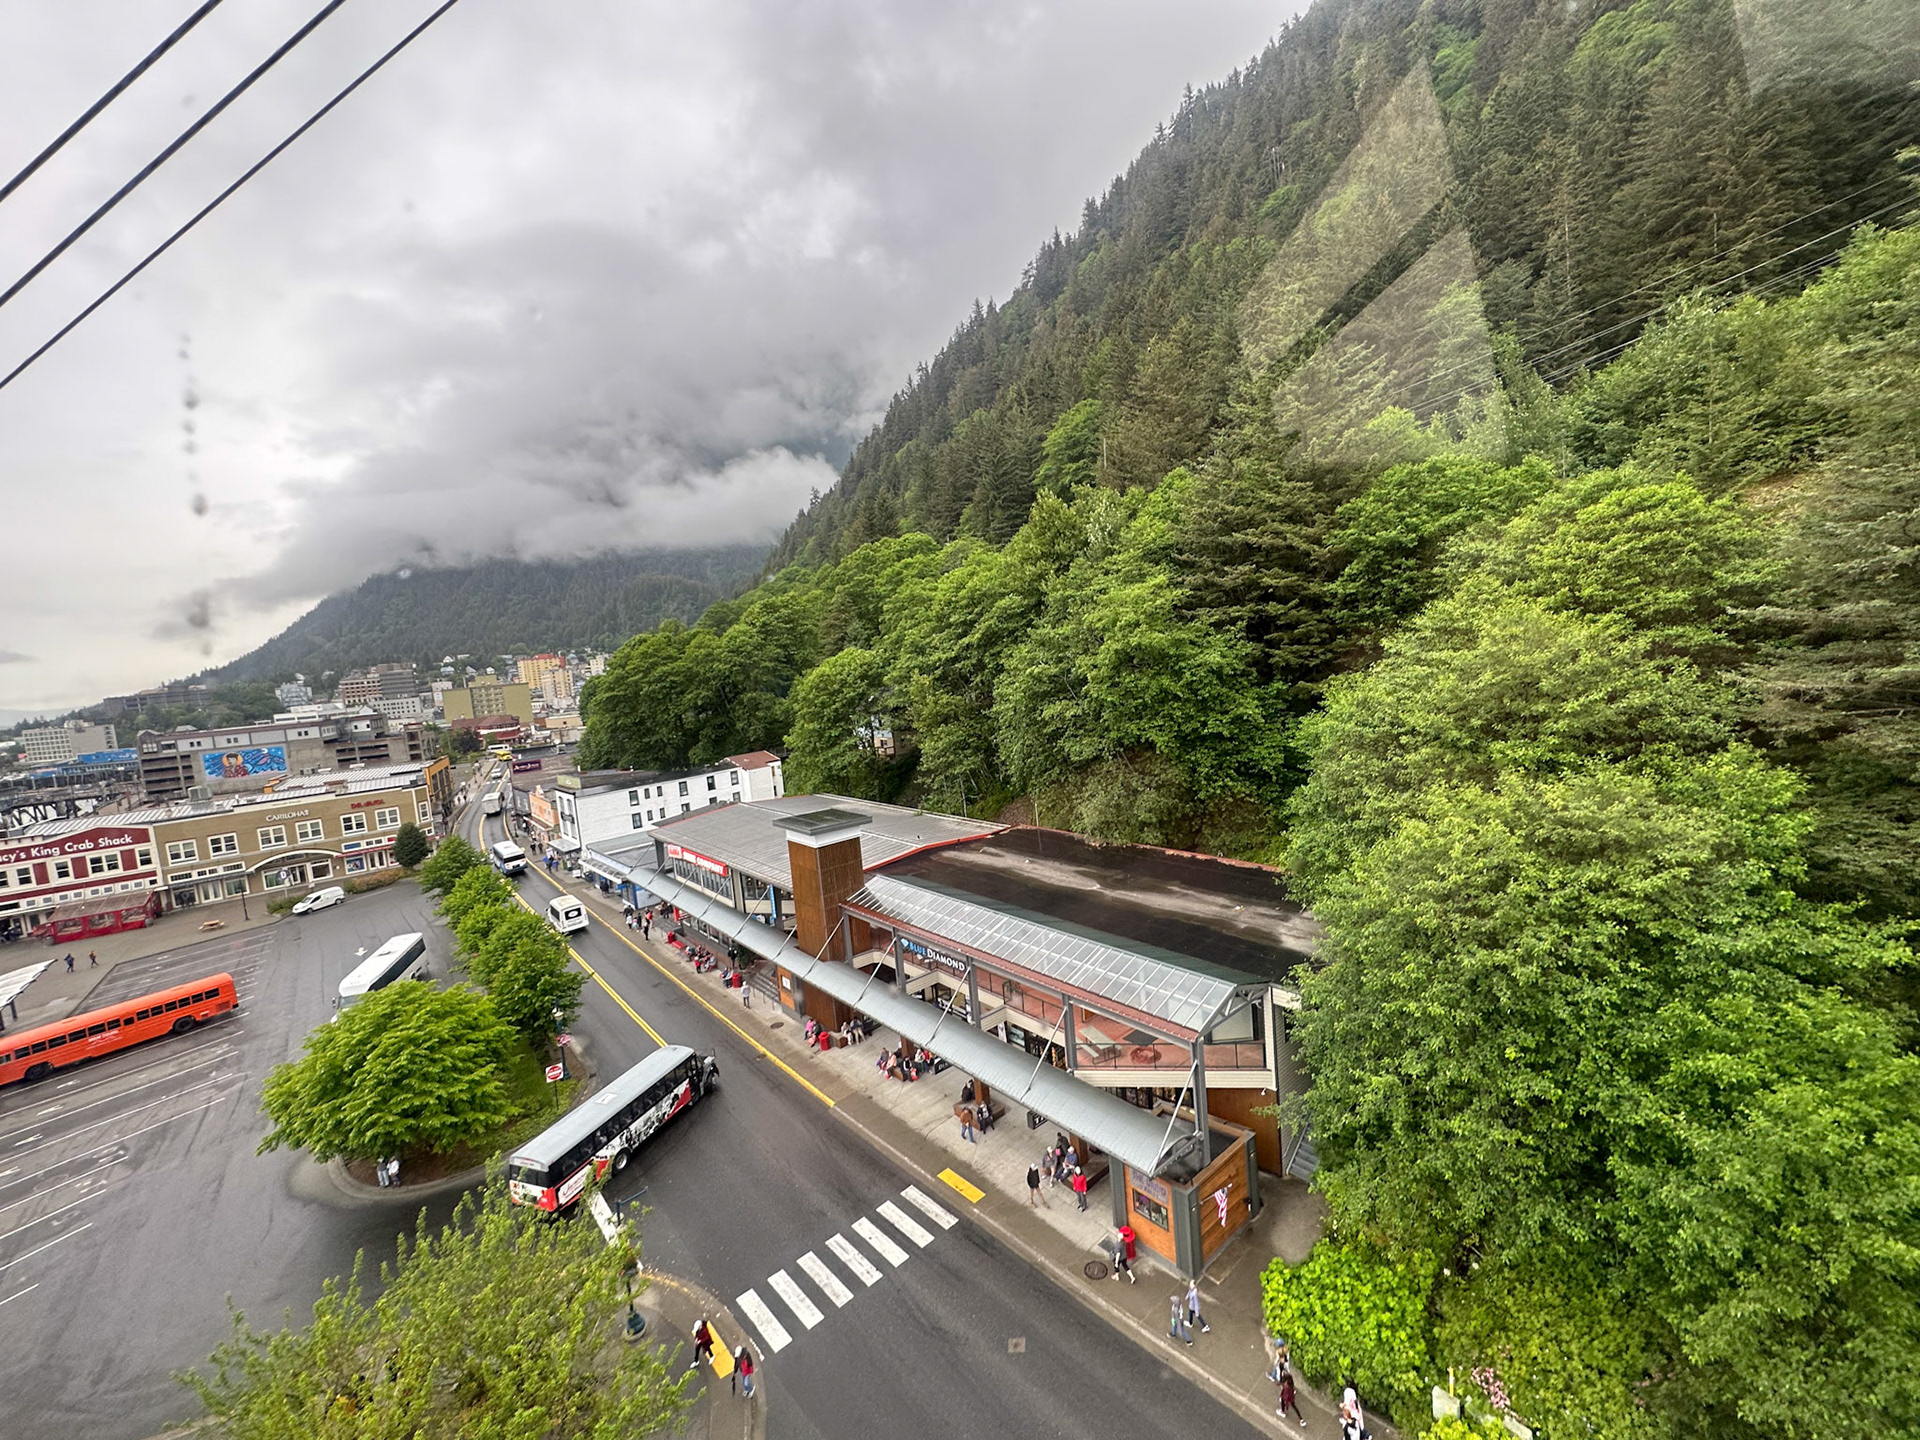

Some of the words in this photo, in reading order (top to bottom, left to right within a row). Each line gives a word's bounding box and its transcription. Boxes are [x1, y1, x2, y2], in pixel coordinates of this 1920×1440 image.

[266, 811, 305, 822] CARILOHA
[31, 846, 60, 857] King
[65, 840, 94, 852] Crab
[98, 834, 132, 848] Shack
[909, 942, 926, 956] BLUE
[927, 948, 965, 971] DIAMOND
